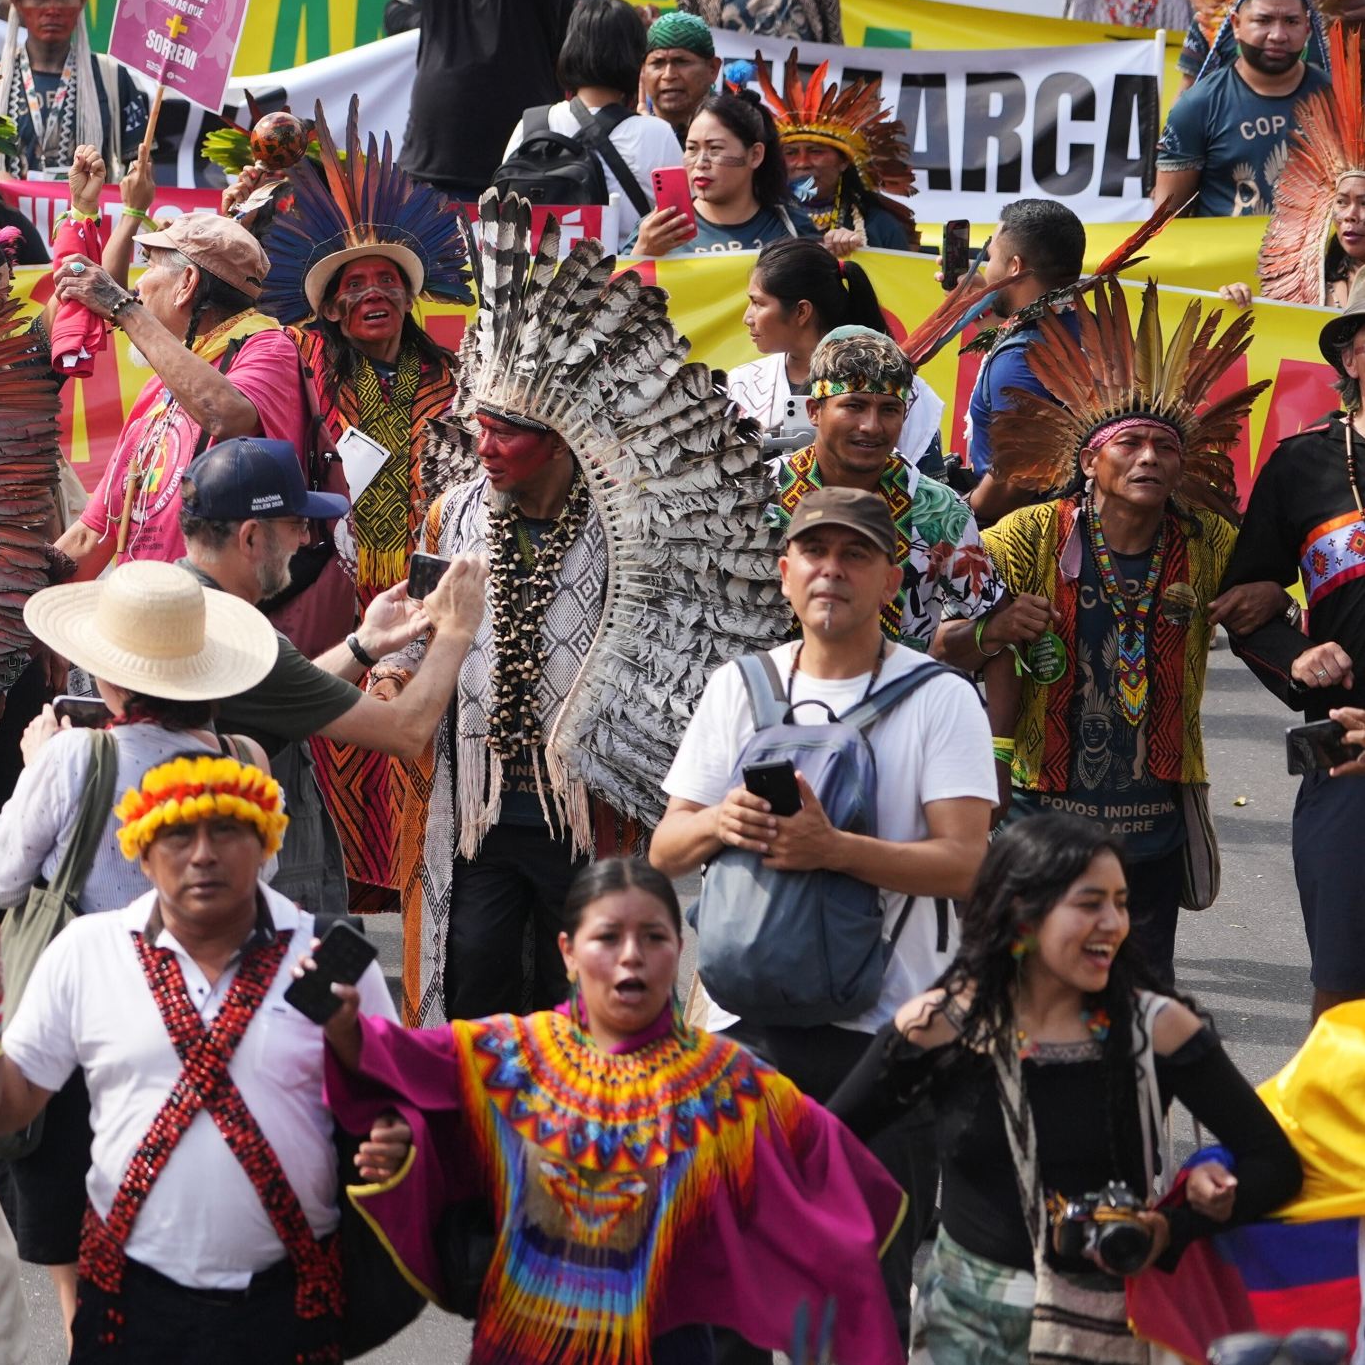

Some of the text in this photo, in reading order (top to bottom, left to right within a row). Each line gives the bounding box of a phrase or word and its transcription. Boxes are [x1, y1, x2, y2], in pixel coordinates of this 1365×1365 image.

[187, 3, 205, 19] QUE
[1240, 115, 1287, 141] COP
[154, 465, 185, 513] NETWORK
[250, 502, 271, 512] BELÉM
[252, 494, 282, 505] AMAZÔNIA
[1040, 794, 1177, 819] POVOS INDÍGENA
[1110, 819, 1155, 835] ACRE
